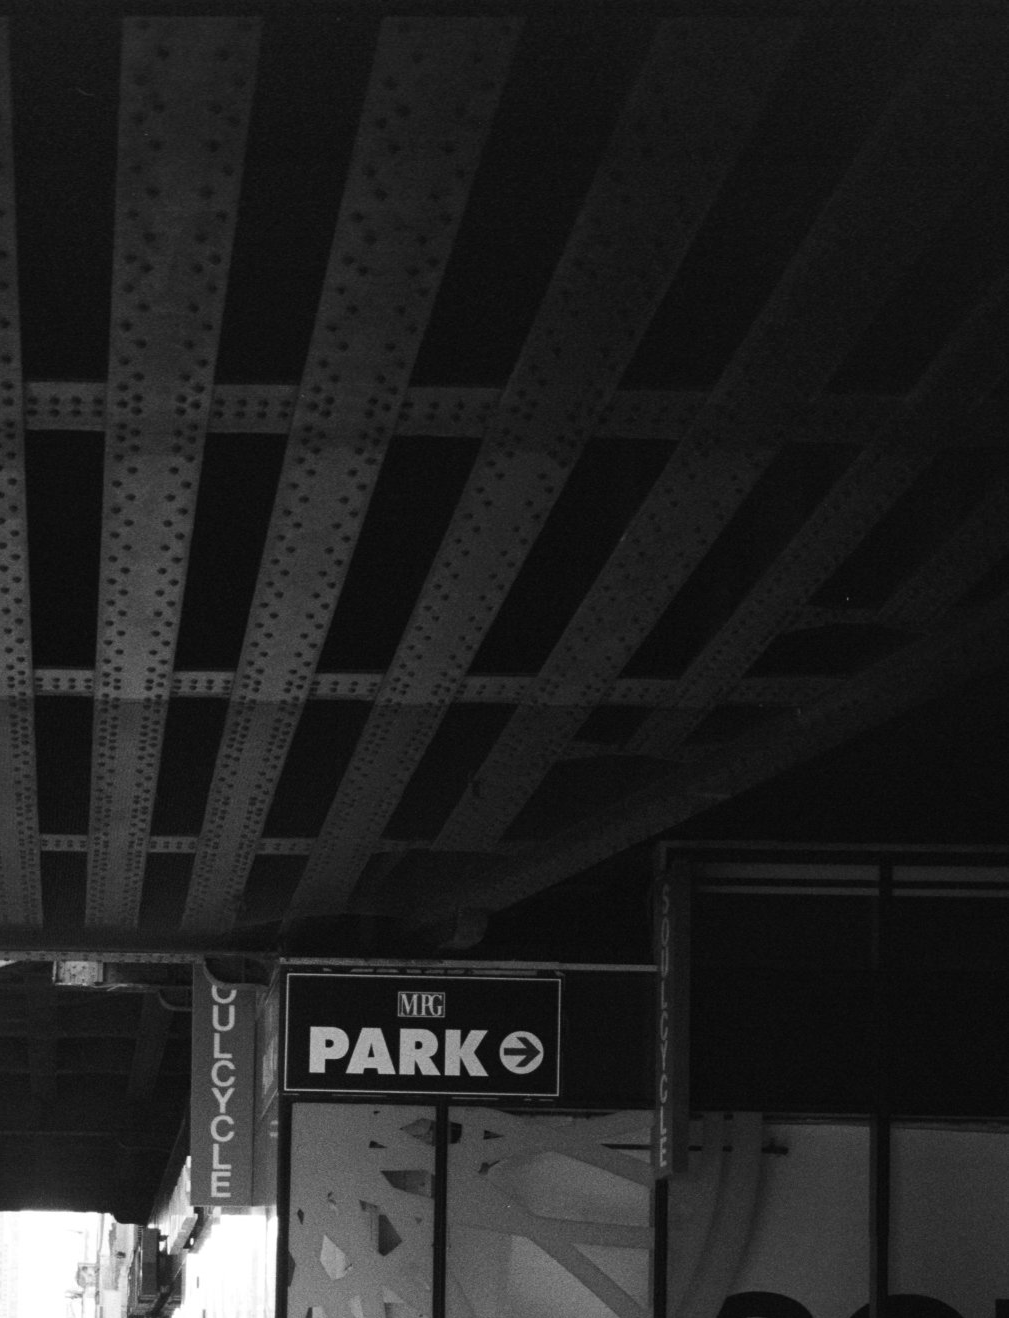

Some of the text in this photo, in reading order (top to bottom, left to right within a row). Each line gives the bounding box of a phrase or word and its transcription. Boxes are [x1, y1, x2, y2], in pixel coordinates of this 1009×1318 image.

[399, 993, 443, 1017] MPG
[659, 883, 670, 1168] SOULCYCLE
[309, 1026, 489, 1077] PARK
